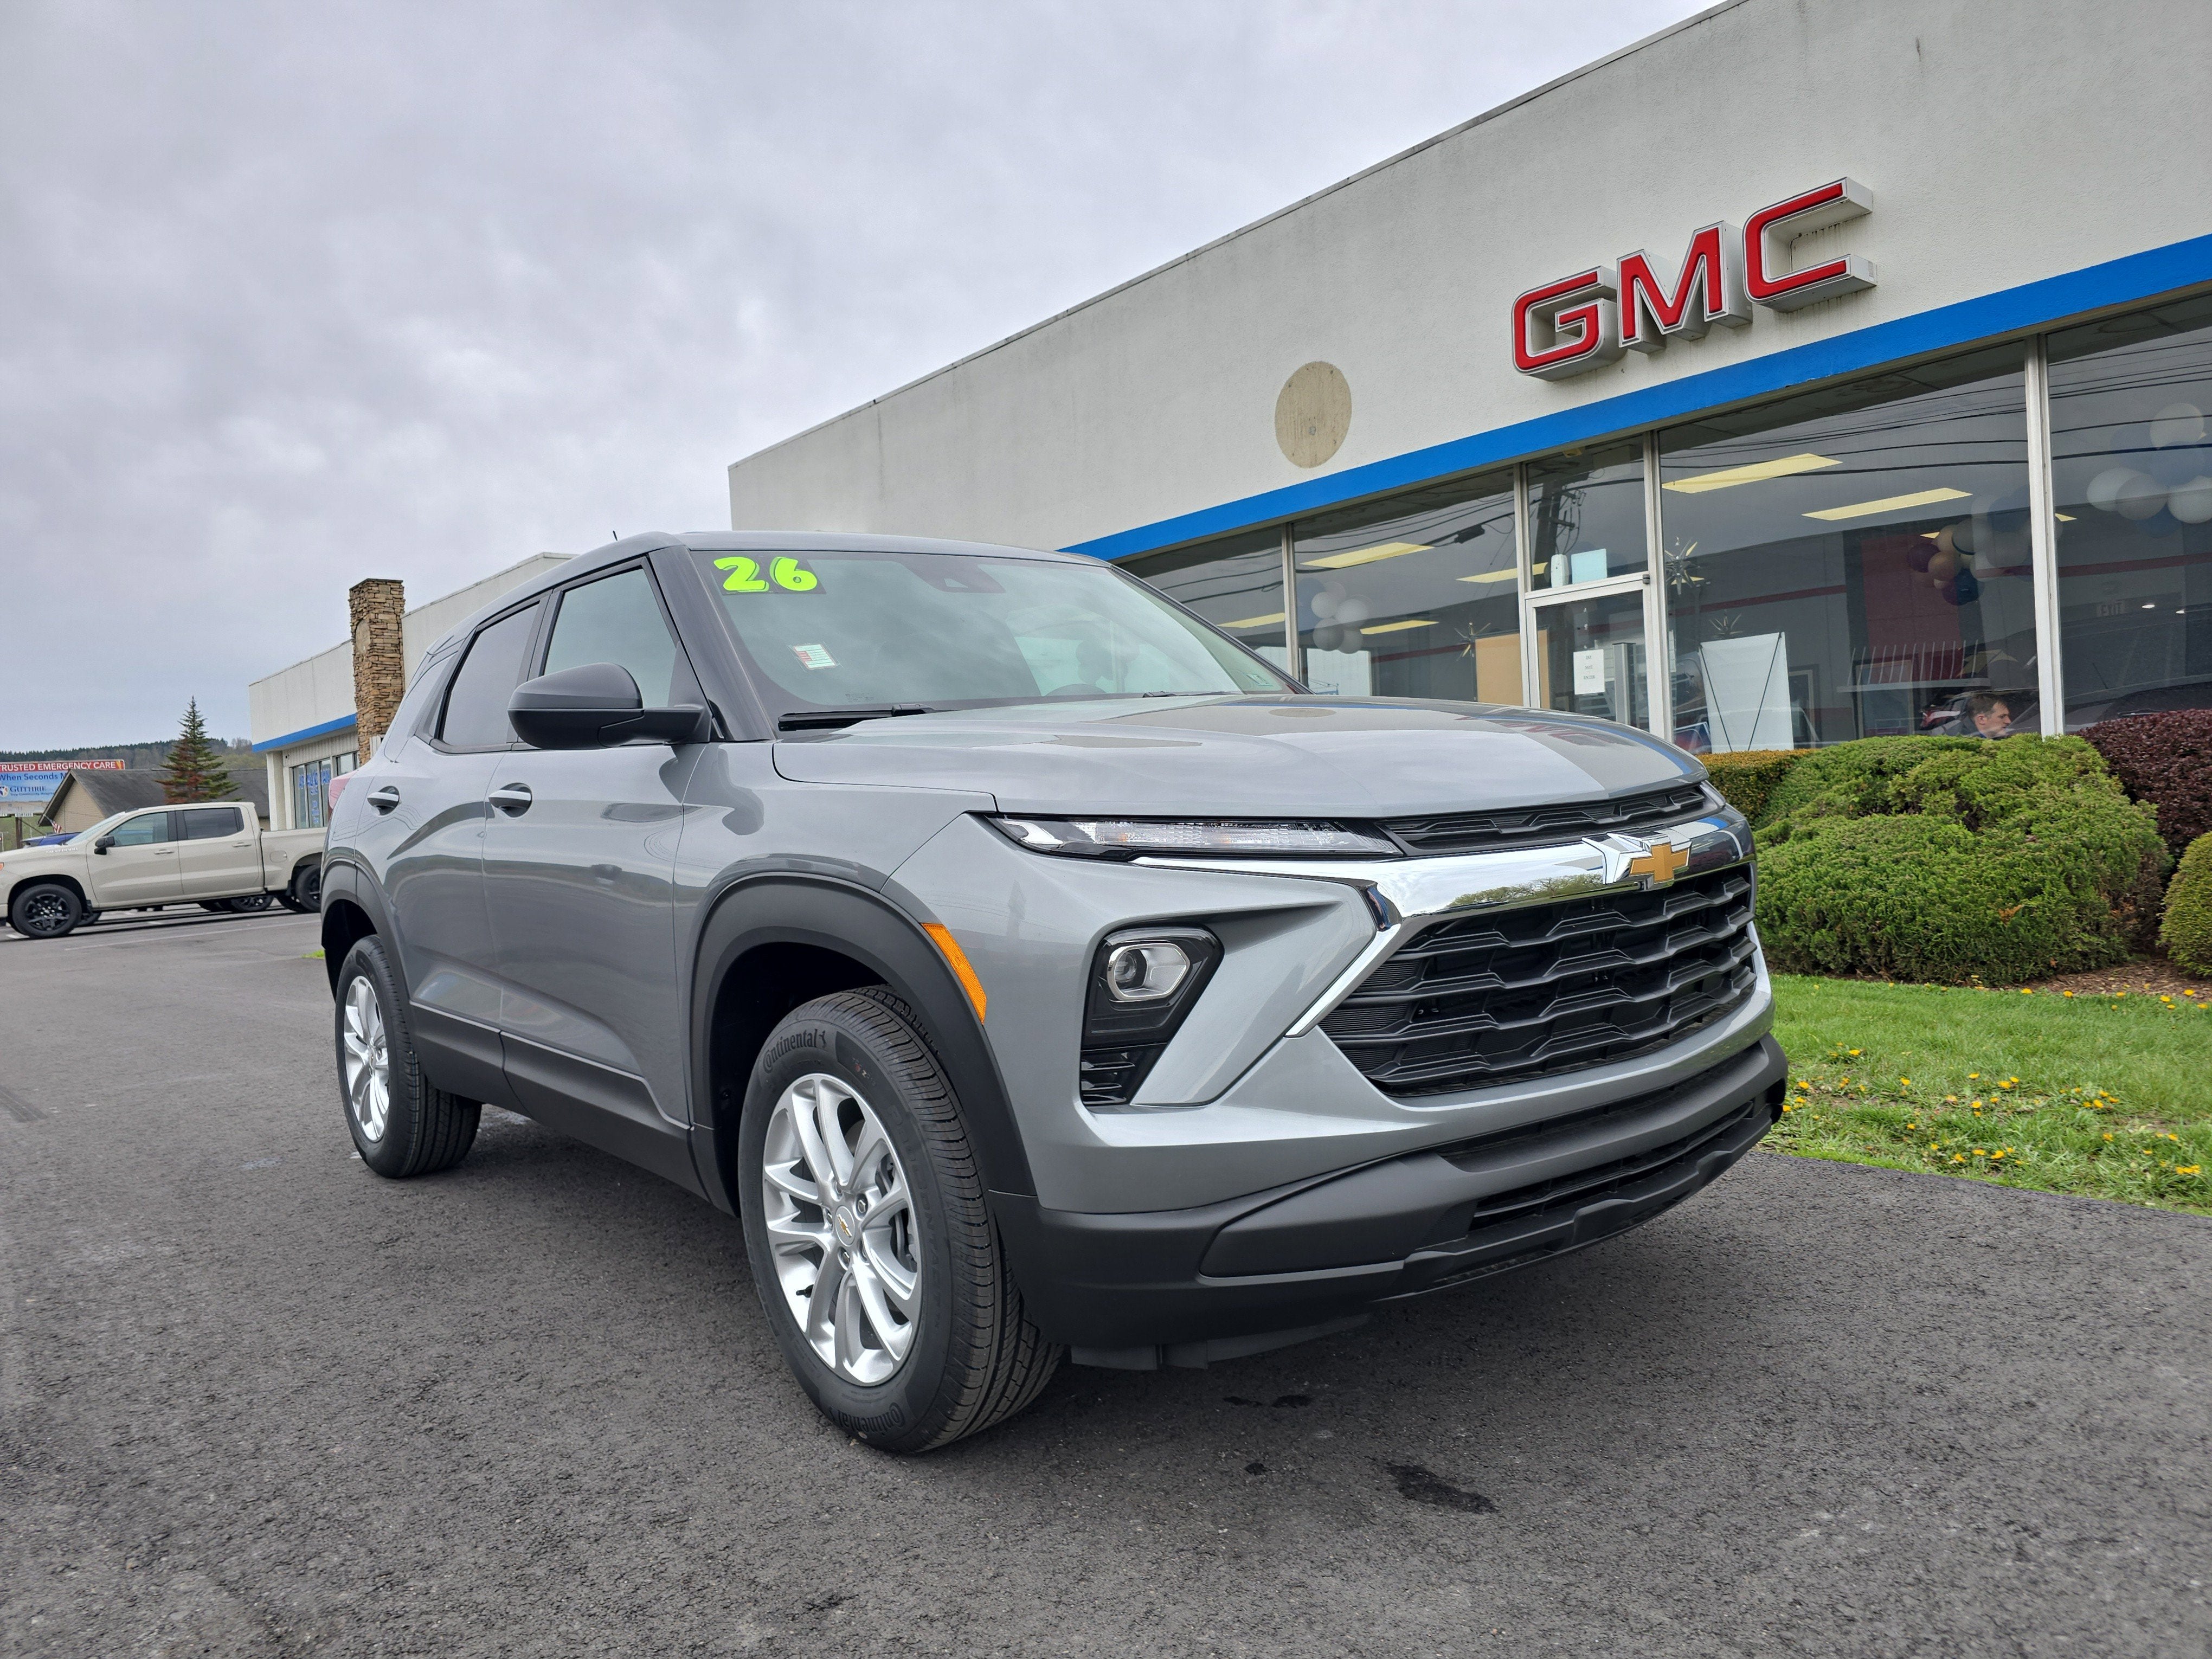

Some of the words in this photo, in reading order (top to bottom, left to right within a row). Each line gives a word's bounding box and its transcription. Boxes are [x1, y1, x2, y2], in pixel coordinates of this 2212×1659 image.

[1512, 177, 1865, 377] GMC
[713, 556, 818, 592] 26
[24, 772, 58, 780] Seconds
[37, 762, 92, 770] EMERGENCY
[93, 761, 116, 769] CARE
[763, 1028, 818, 1073] Continental
